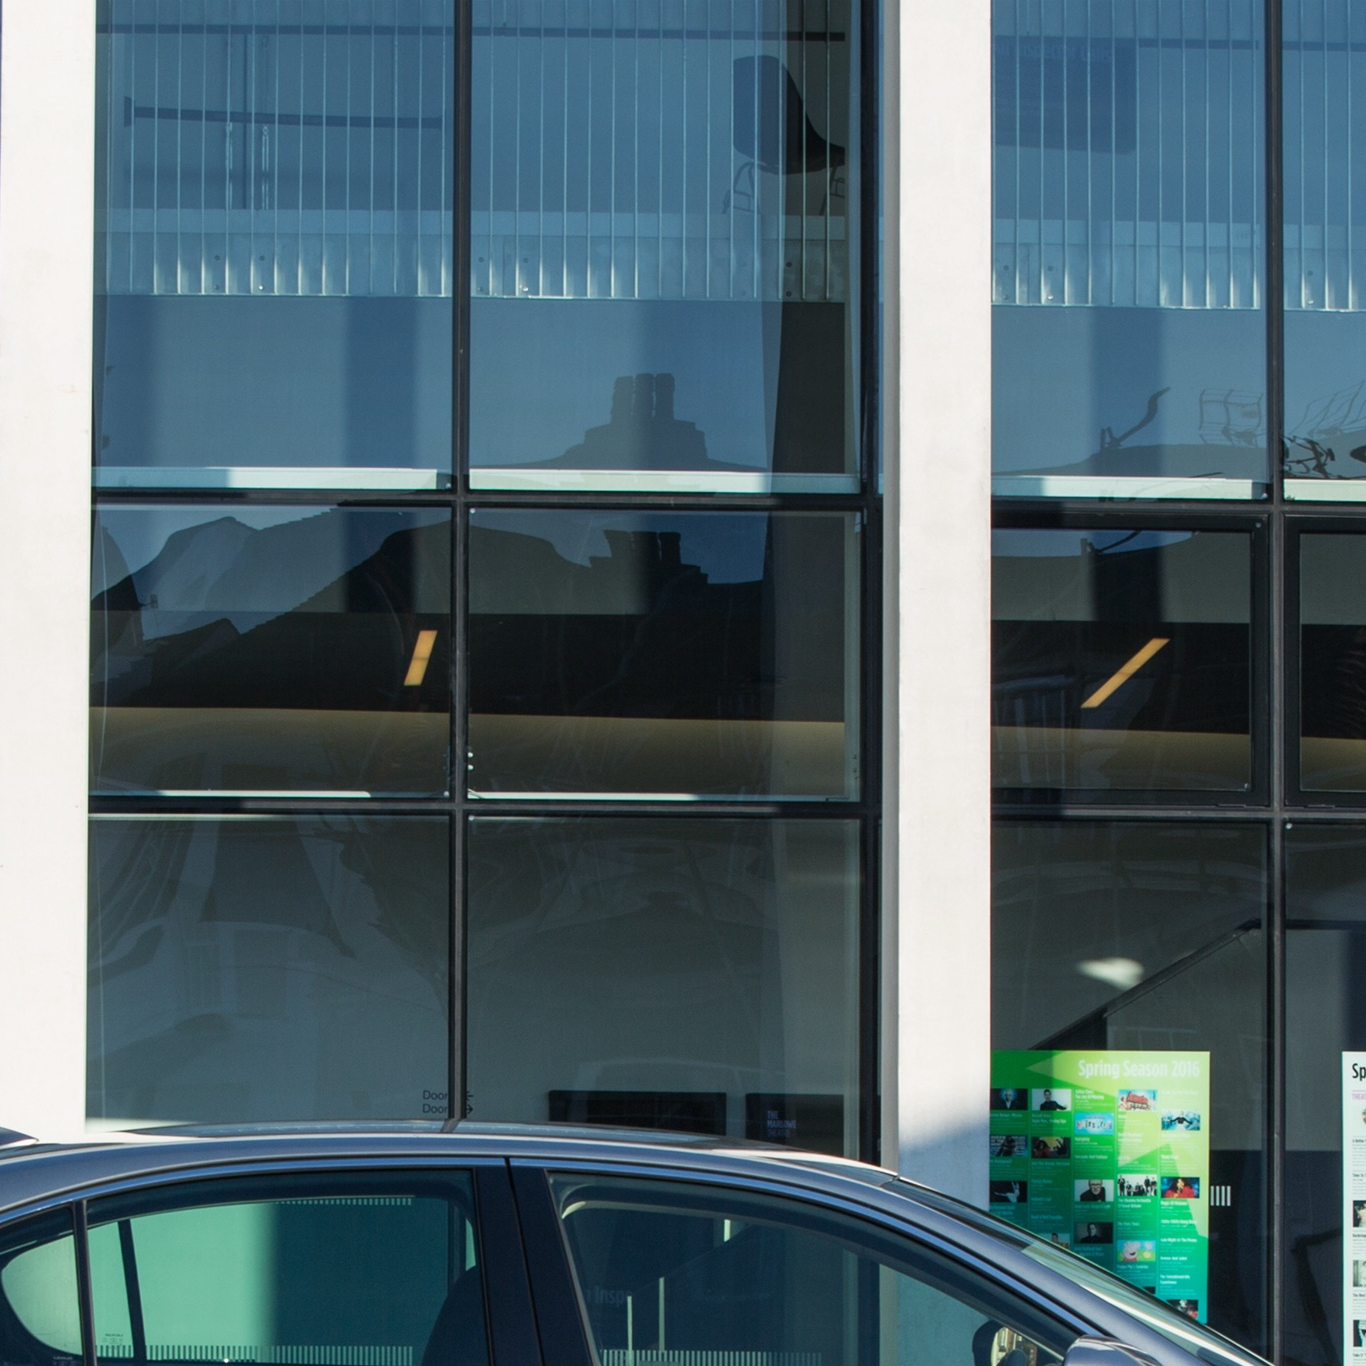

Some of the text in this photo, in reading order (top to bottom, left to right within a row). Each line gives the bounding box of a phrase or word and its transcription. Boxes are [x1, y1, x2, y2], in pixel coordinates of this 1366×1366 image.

[1078, 1060, 1200, 1078] Spring Season 2016
[422, 1089, 448, 1100] Door
[422, 1103, 448, 1114] Door
